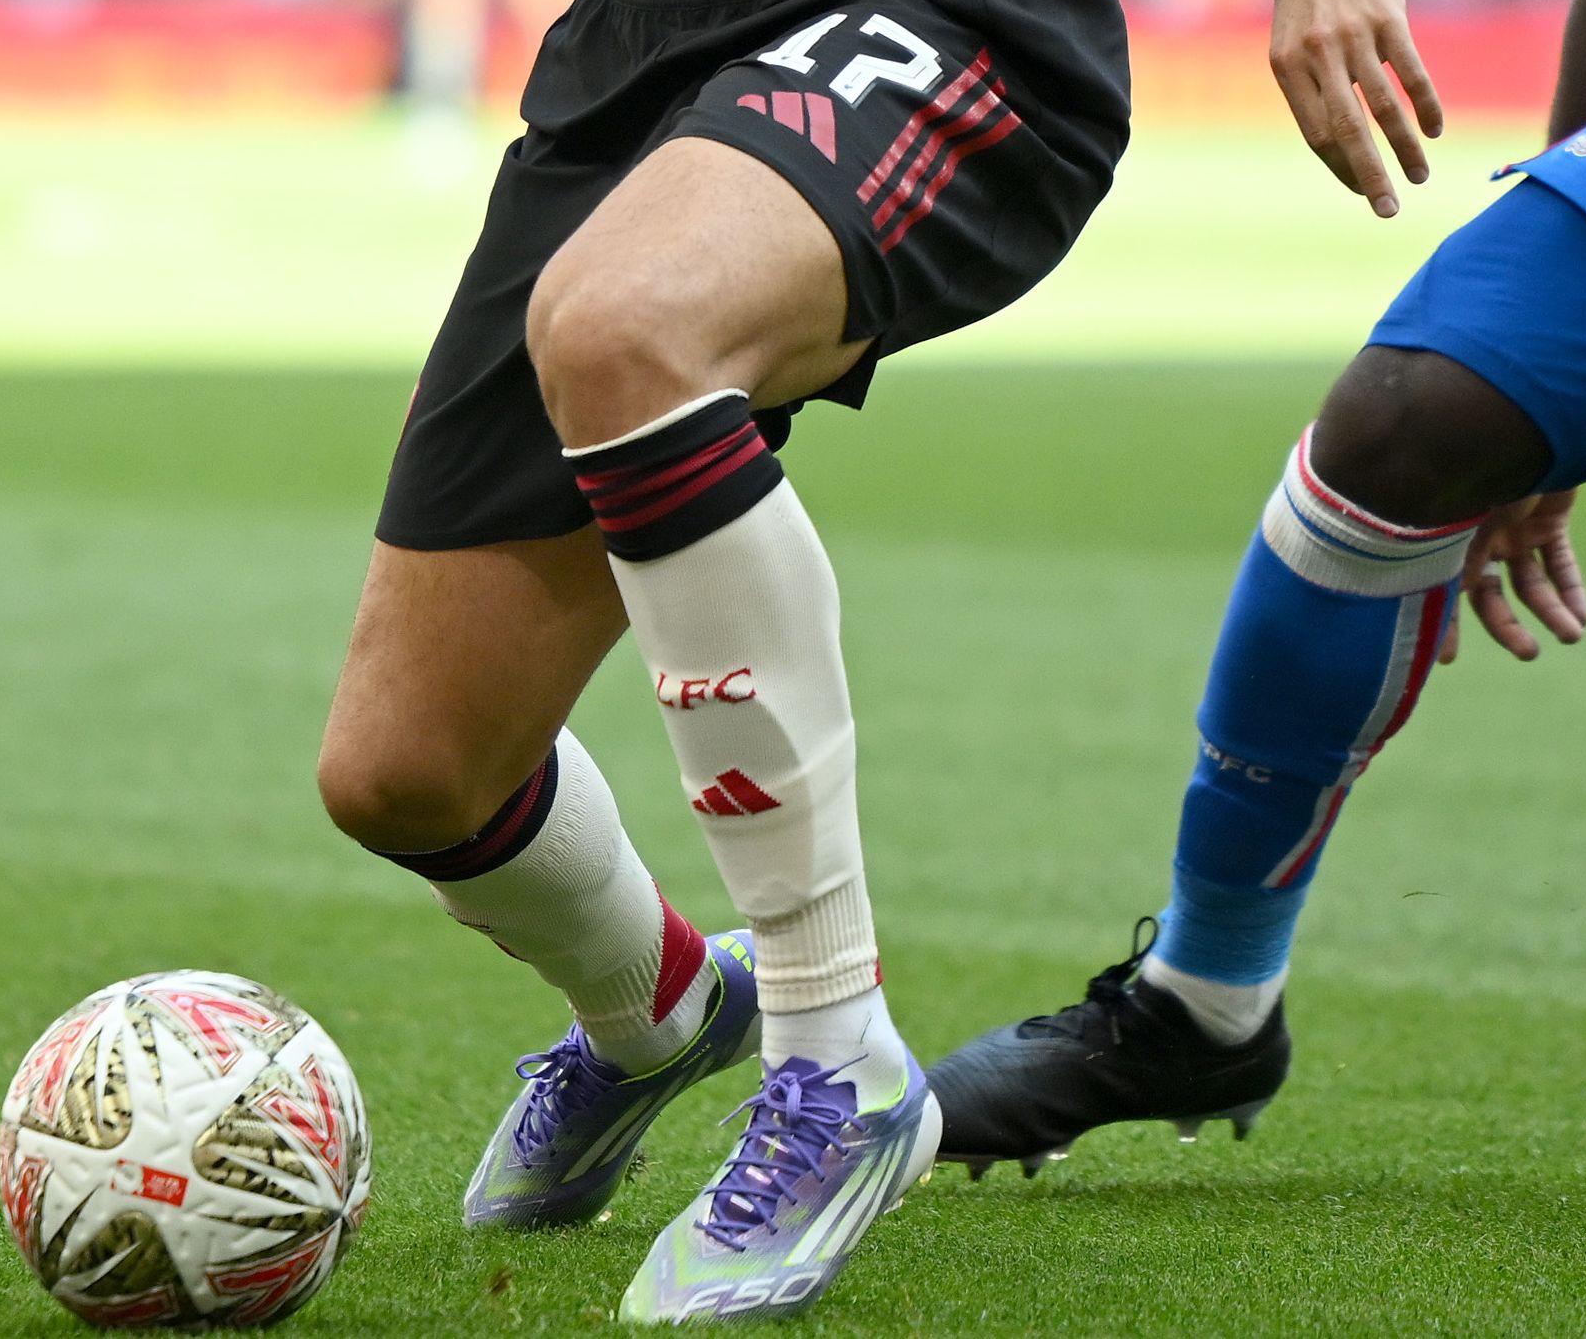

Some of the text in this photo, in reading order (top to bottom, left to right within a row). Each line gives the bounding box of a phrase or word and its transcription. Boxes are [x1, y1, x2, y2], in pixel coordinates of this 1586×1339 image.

[757, 13, 944, 109] 17
[657, 667, 756, 710] LFC
[1200, 734, 1273, 783] PFC
[674, 1270, 823, 1326] F50
